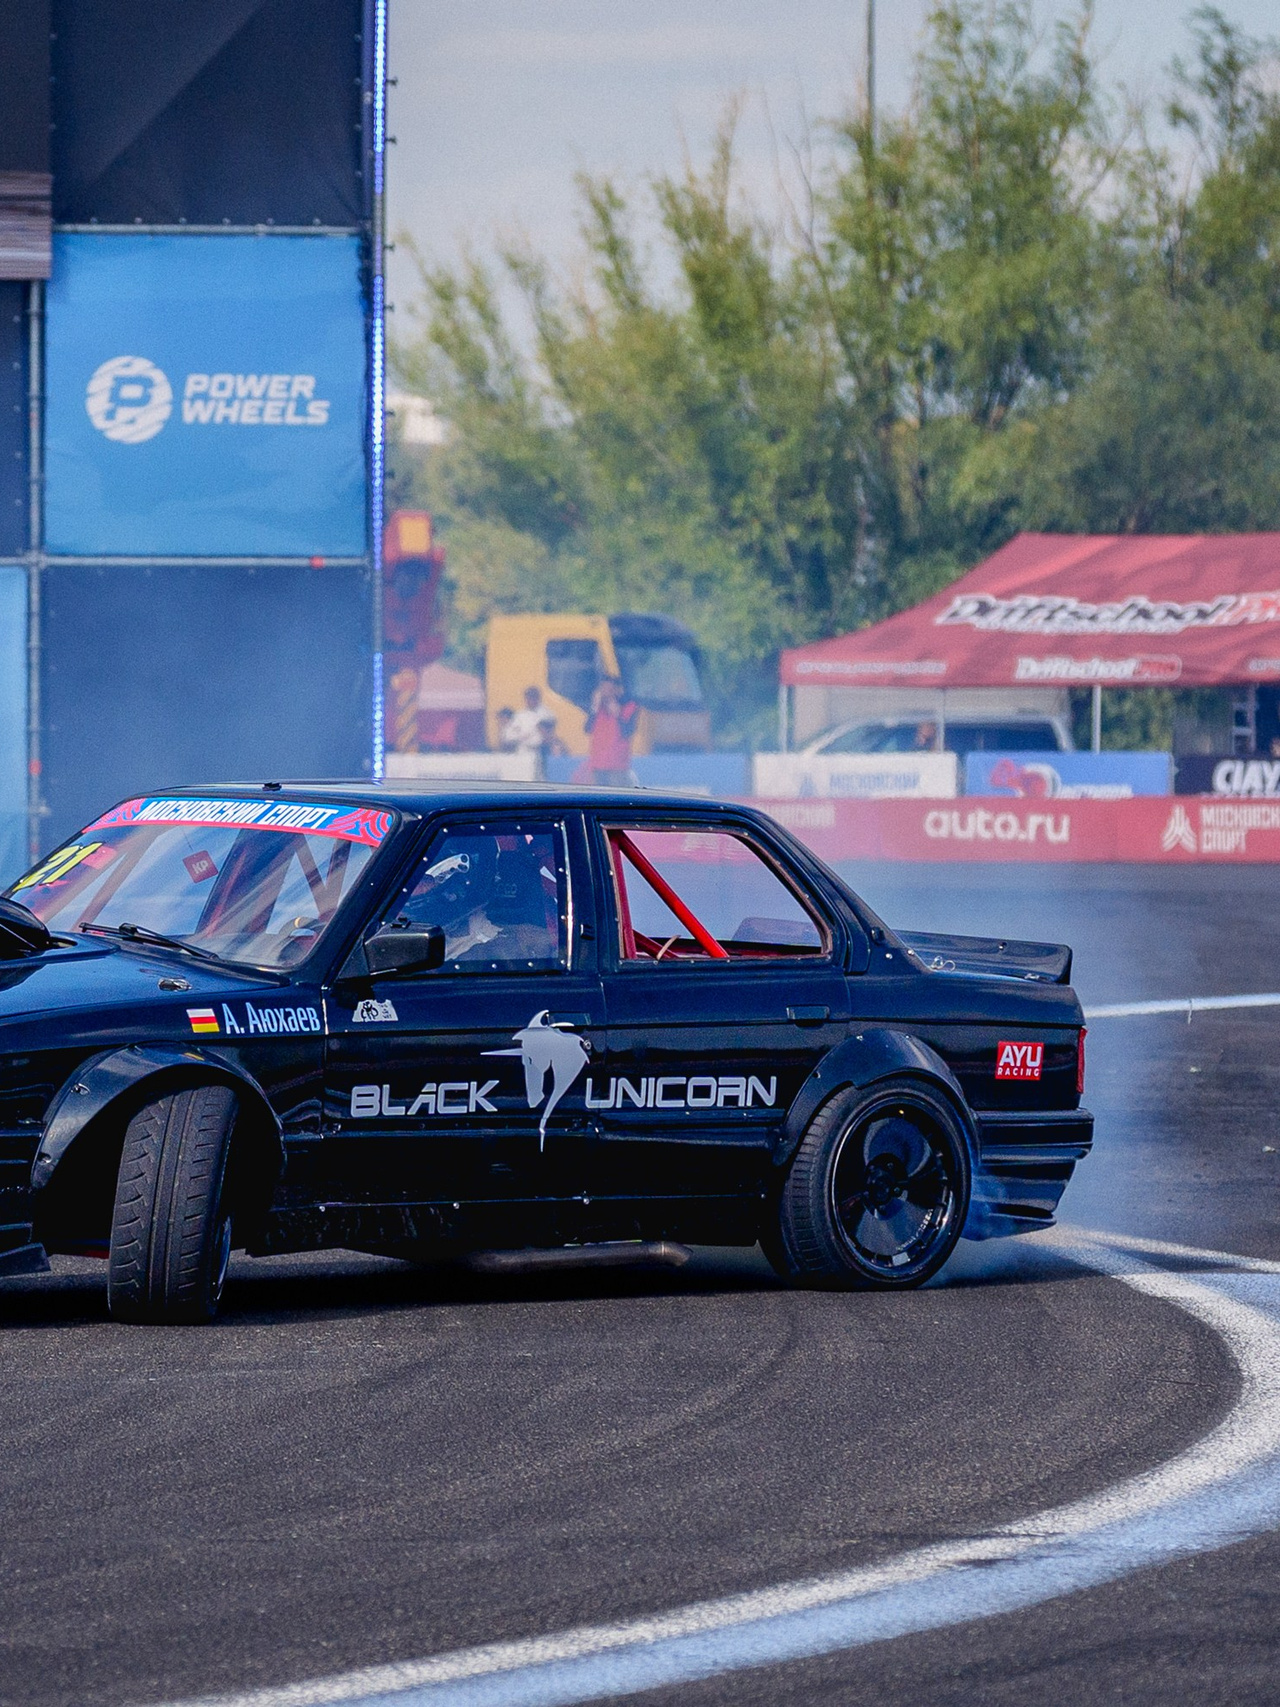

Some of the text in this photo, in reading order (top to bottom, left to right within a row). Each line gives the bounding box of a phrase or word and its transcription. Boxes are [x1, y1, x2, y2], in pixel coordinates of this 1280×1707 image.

[185, 374, 317, 399] POWER
[182, 400, 331, 425] WHEELS
[133, 800, 339, 829] МОСКОВСКИЙ СПОРТ
[925, 807, 1069, 842] auto.ru
[222, 1002, 321, 1034] А. Аюхаев
[999, 1045, 1042, 1067] AYU
[997, 1067, 1040, 1077] RACING
[350, 1075, 777, 1117] BLACK UNICORN
